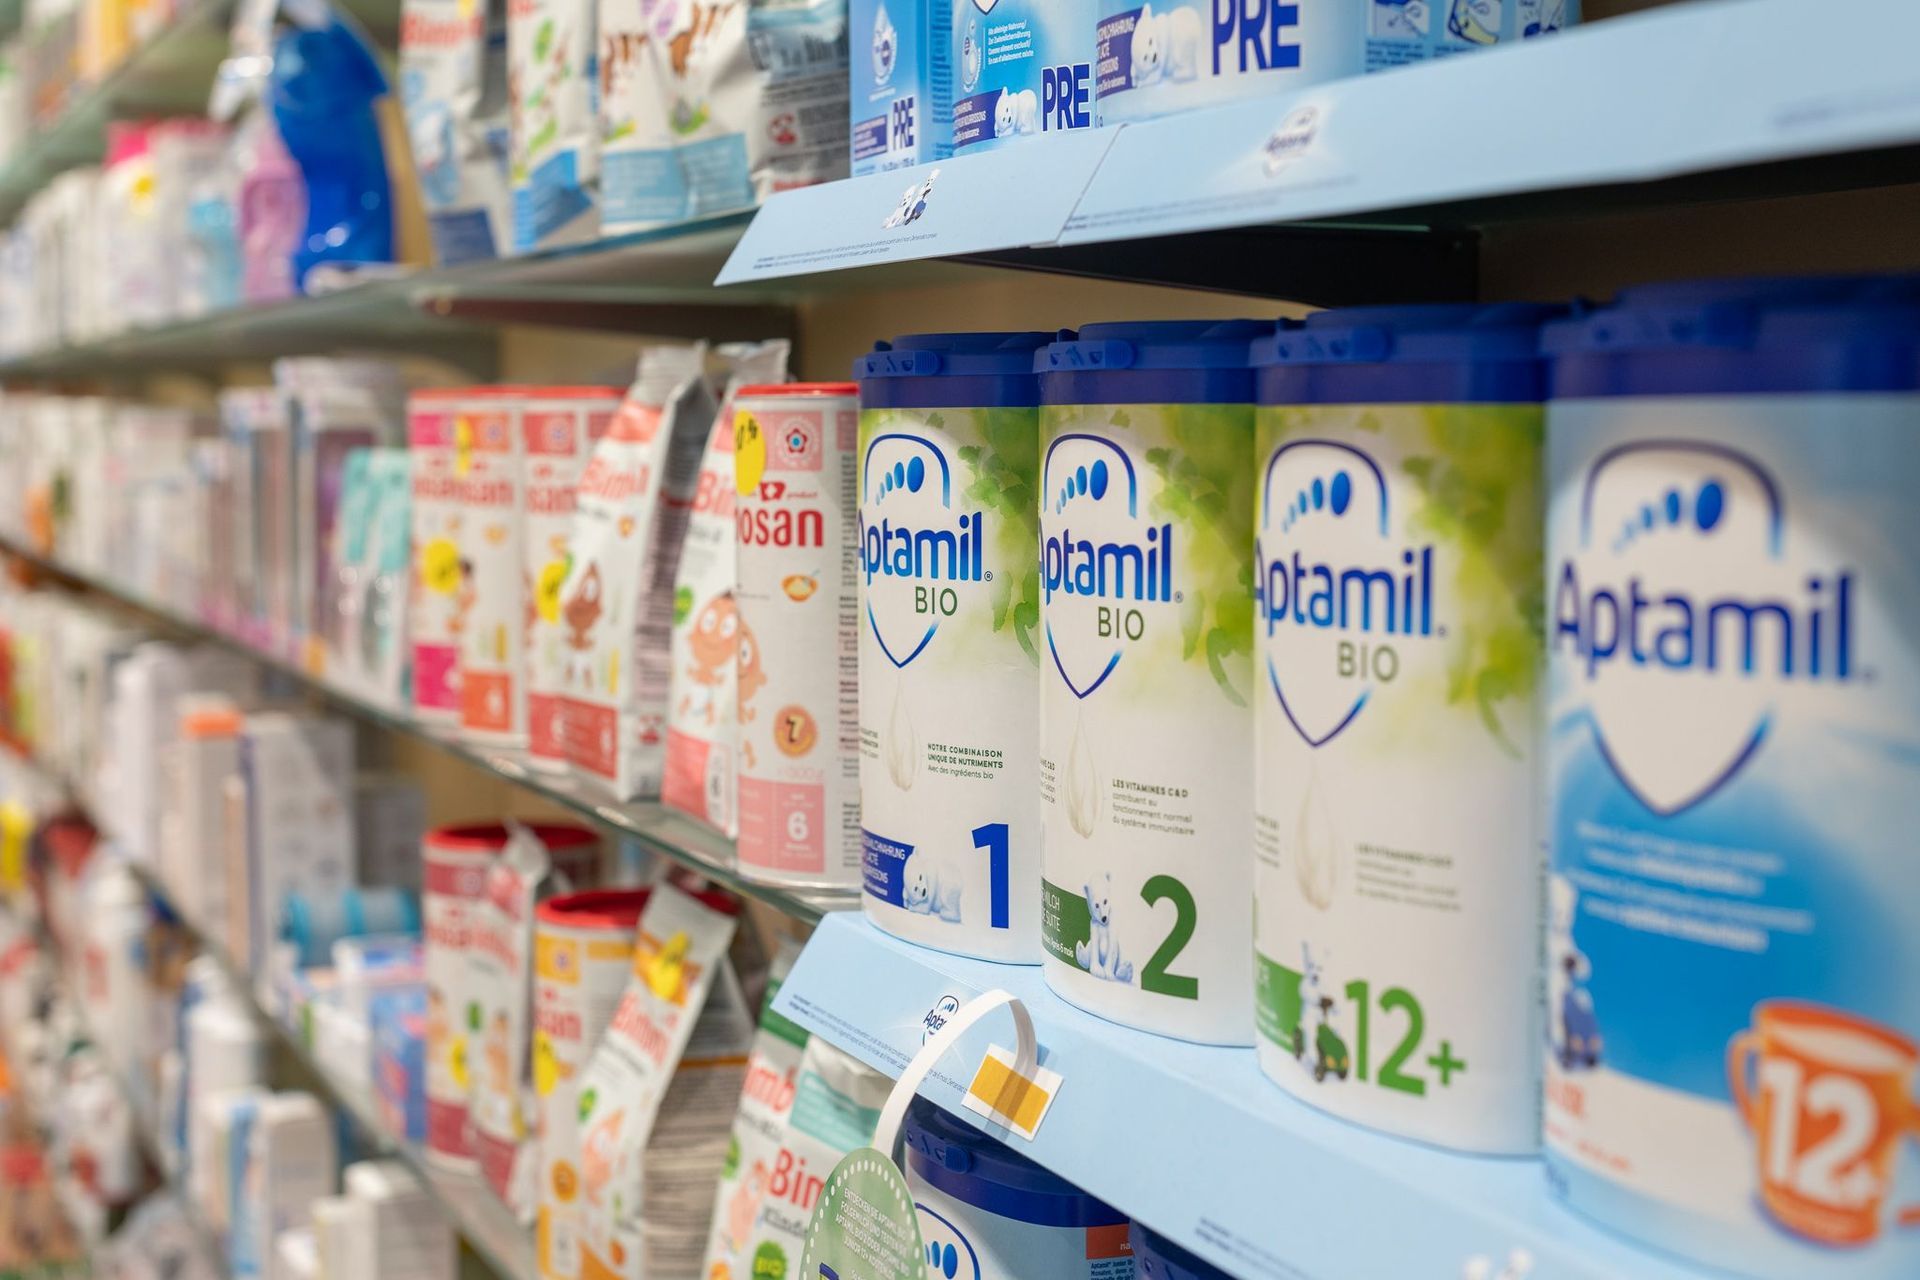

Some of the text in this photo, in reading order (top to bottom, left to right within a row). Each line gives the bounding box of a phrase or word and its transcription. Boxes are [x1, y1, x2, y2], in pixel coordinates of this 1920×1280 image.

[1212, 0, 1302, 76] PRE
[1043, 64, 1090, 131] PRE
[893, 97, 914, 151] PRE
[915, 585, 958, 616] BIO
[1098, 606, 1144, 640] BIO
[1555, 560, 1856, 681] Aptamil
[1337, 641, 1399, 682] BIO
[928, 743, 1002, 758] NOTRE COMBINAISON
[928, 753, 1003, 769] UNIQUE DE NUTRIMENTS
[983, 771, 994, 780] bio
[1112, 778, 1124, 789] LES
[1126, 781, 1166, 796] VITAMINES
[788, 811, 809, 841] 6
[1148, 821, 1195, 836] immunitaire
[1163, 812, 1192, 823] normal
[971, 823, 1009, 929] 1
[1140, 874, 1199, 1000] 2
[1344, 978, 1467, 1098] 12+
